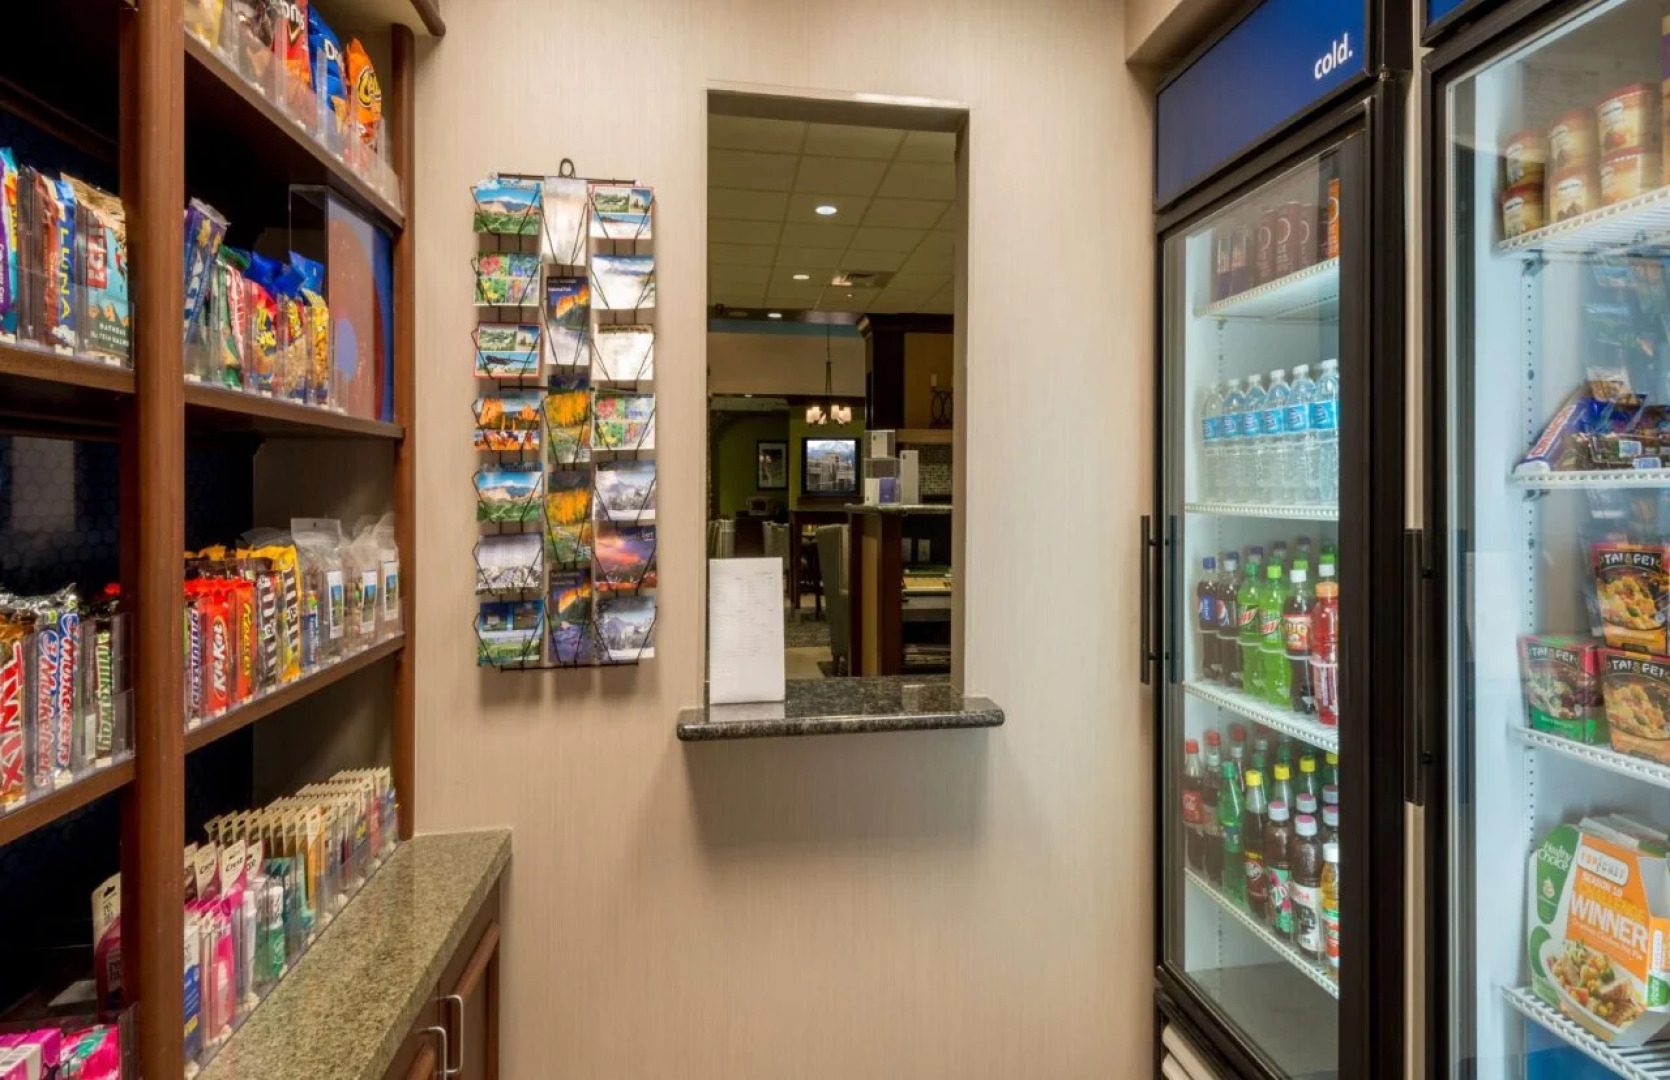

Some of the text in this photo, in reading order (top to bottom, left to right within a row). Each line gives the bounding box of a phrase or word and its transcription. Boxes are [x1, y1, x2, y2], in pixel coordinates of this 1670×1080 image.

[1314, 32, 1353, 79] cold.
[59, 227, 71, 320] LUNA
[1604, 552, 1623, 565] TAI
[1612, 659, 1632, 670] TAI
[0, 642, 25, 792] TWIX
[1537, 847, 1569, 872] Choice
[1544, 841, 1573, 861] Healthy
[226, 857, 243, 872] Crest
[1571, 894, 1648, 955] WINNER
